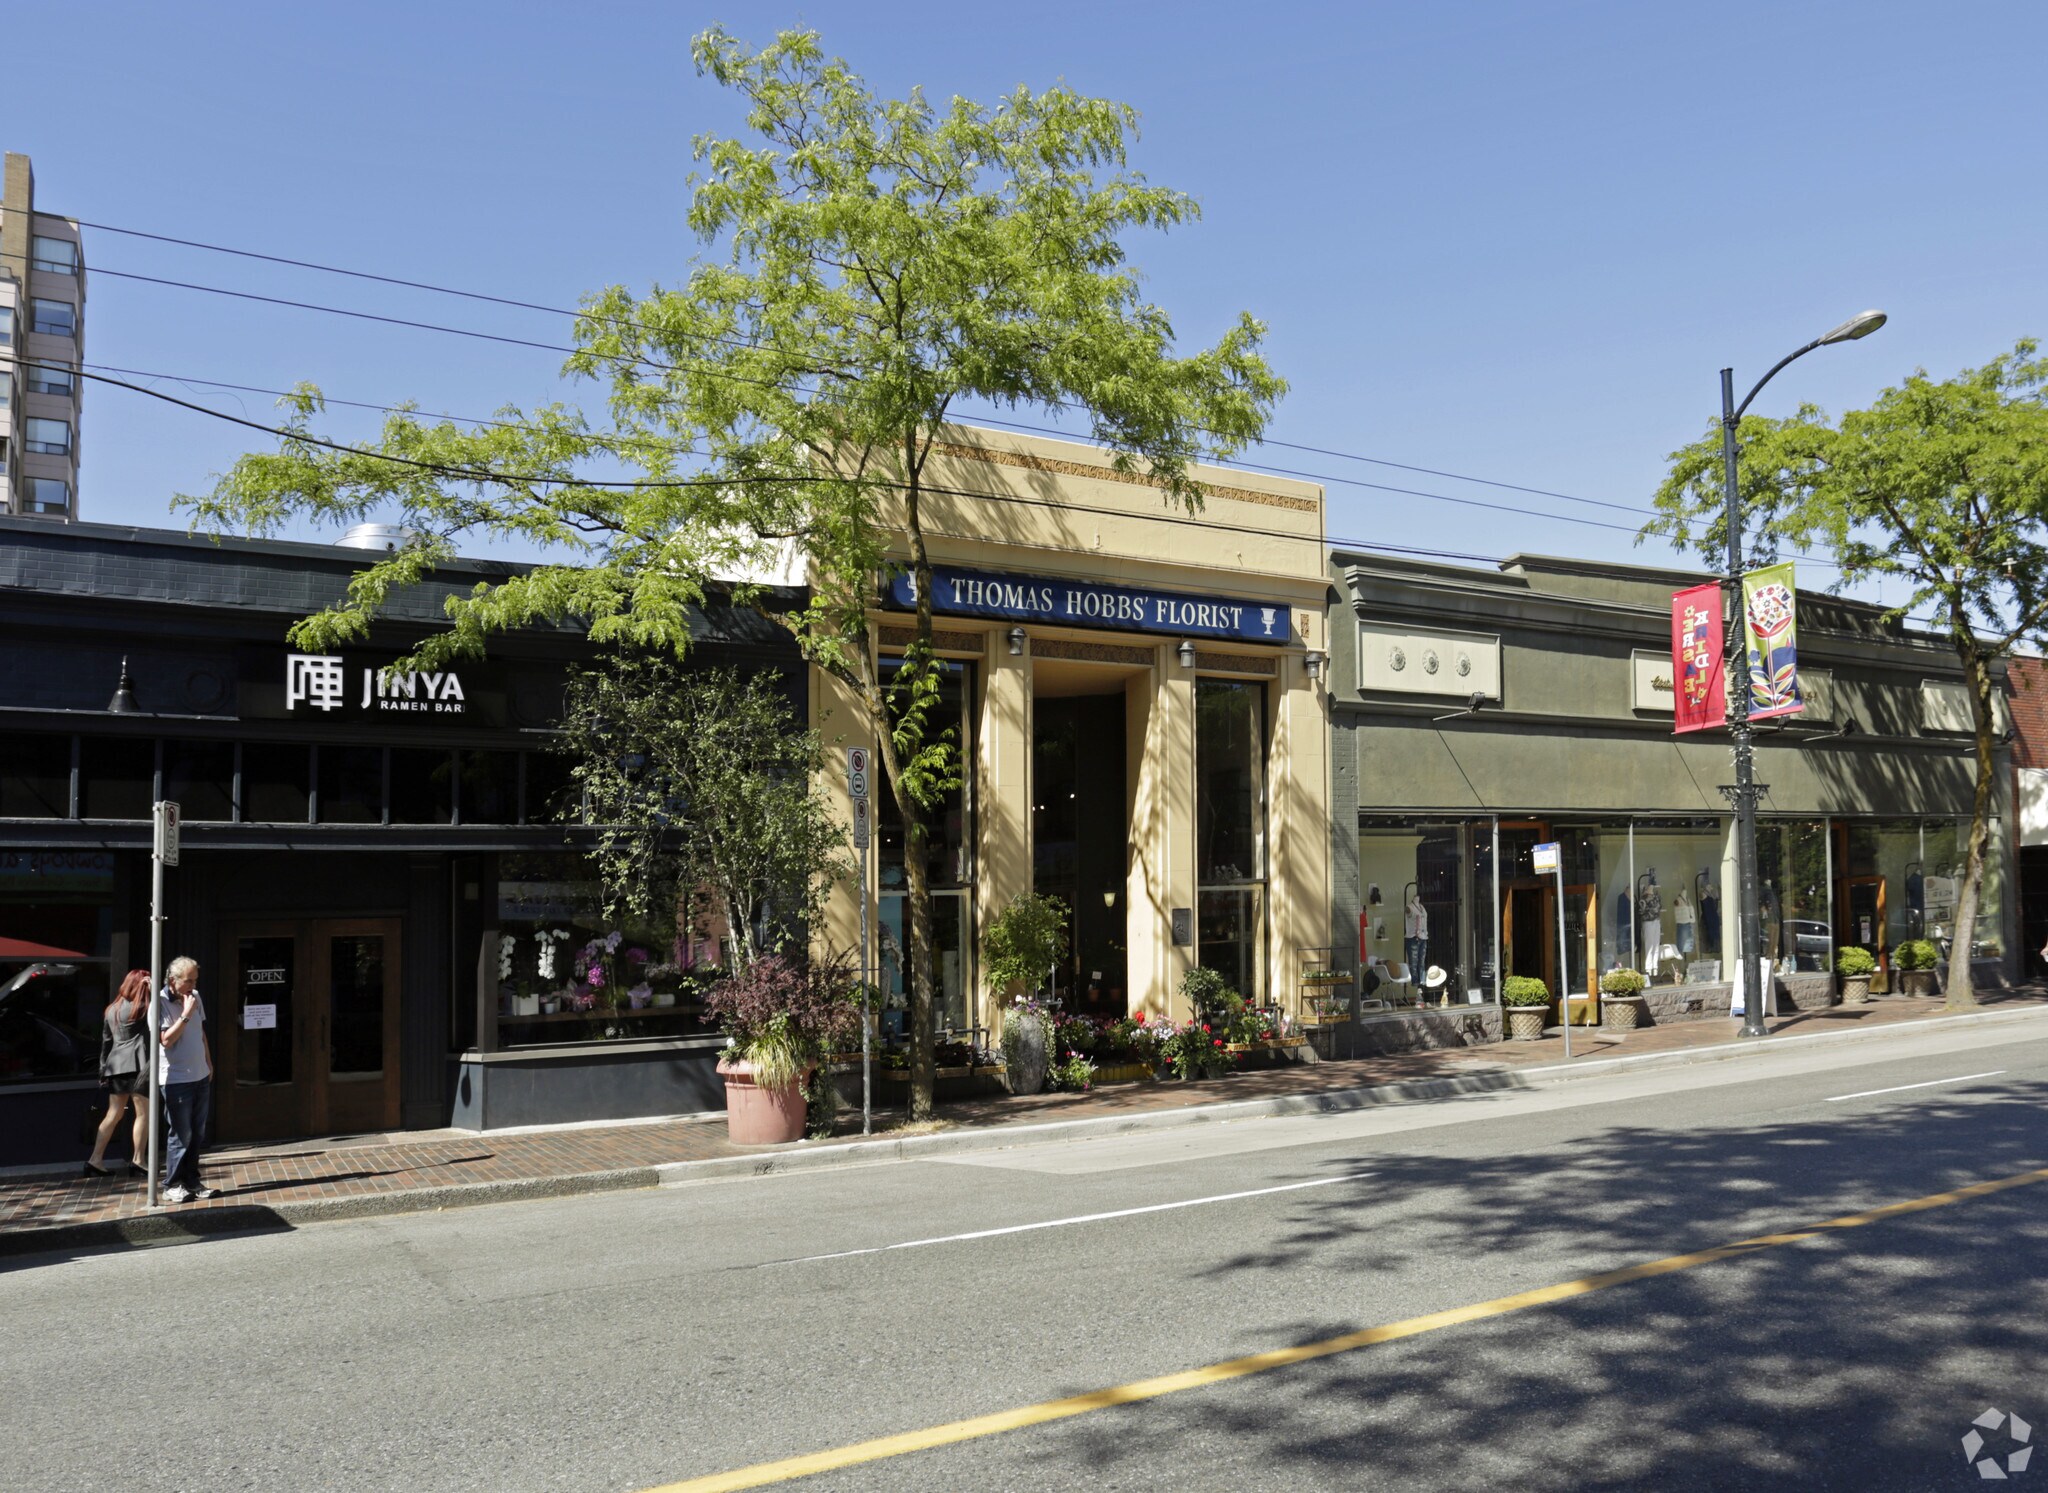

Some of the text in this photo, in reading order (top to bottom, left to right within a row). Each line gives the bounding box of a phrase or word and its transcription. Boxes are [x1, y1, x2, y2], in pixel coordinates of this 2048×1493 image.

[950, 577, 1243, 630] THOMAS HOBBS' FLORIST
[360, 668, 465, 709] JINYA
[380, 700, 462, 713] RAMEN BAR
[250, 971, 282, 982] OPEN
